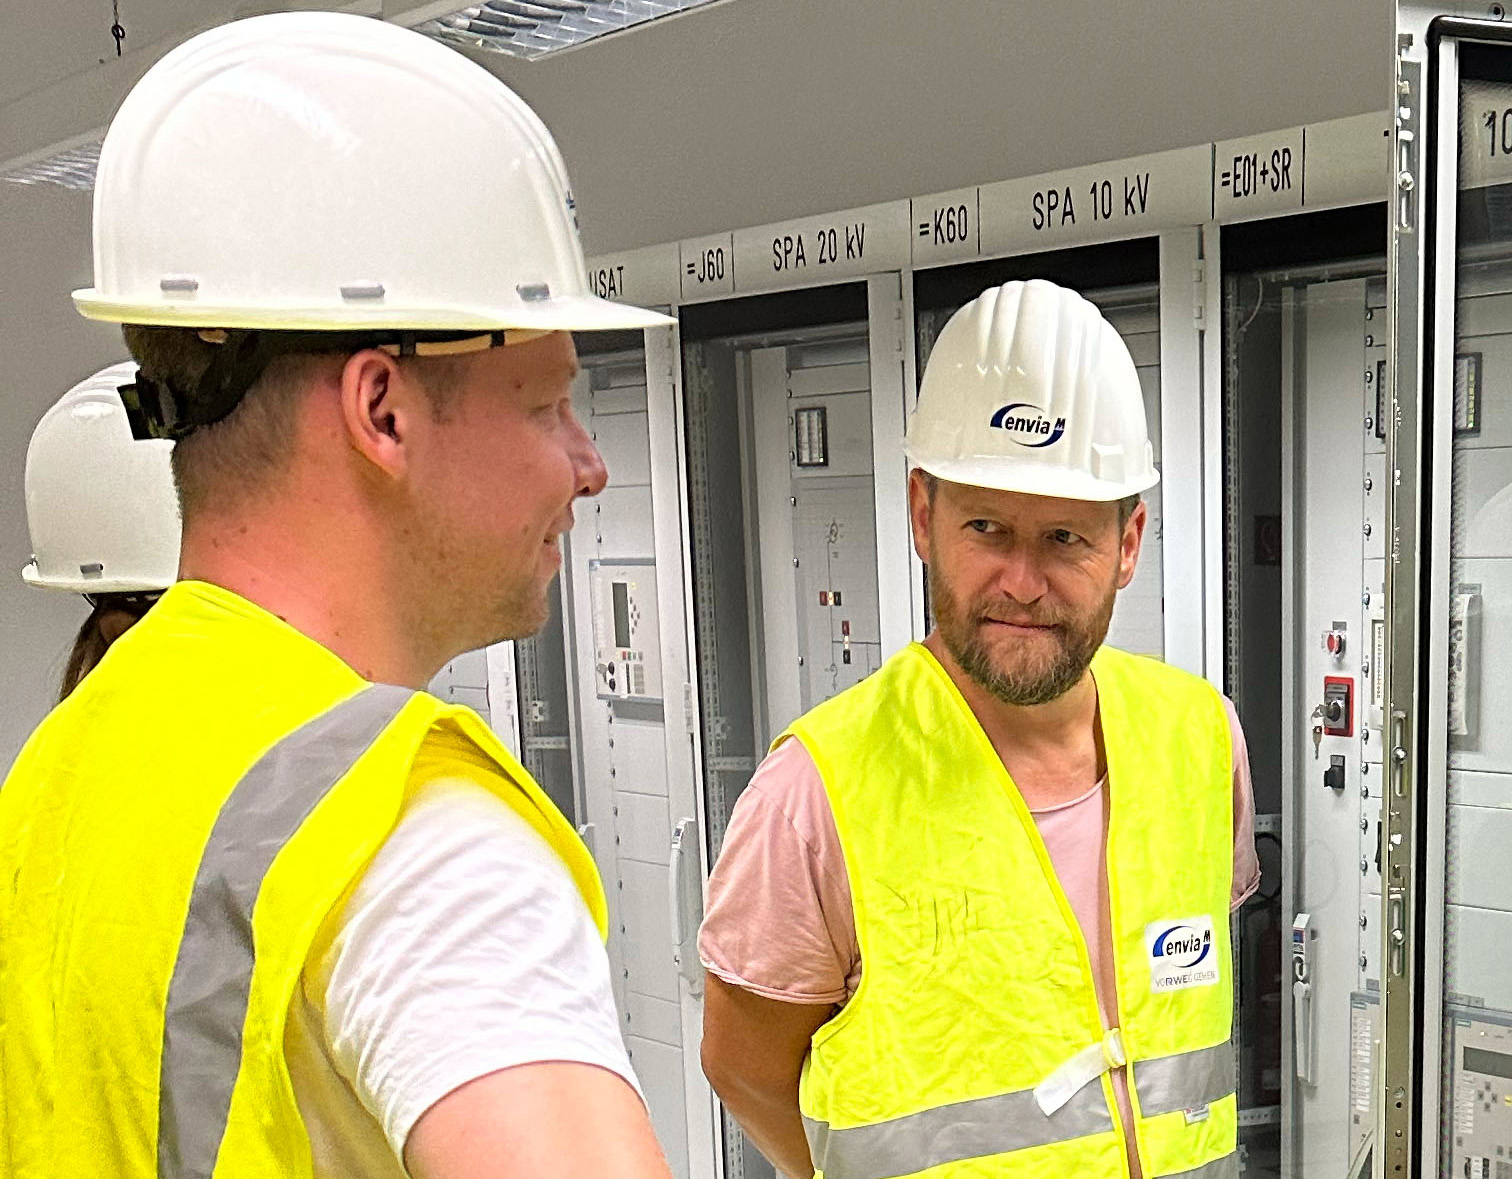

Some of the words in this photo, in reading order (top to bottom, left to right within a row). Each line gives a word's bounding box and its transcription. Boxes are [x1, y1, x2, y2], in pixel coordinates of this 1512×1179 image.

[1221, 147, 1292, 199] =E01+SR
[919, 204, 968, 246] =K60
[1032, 186, 1076, 231] SPA
[1090, 181, 1113, 221] 10
[1124, 173, 1150, 216] kV
[686, 248, 725, 284] =J60
[772, 235, 806, 272] SPA
[817, 228, 837, 265] 20
[845, 222, 865, 260] kV
